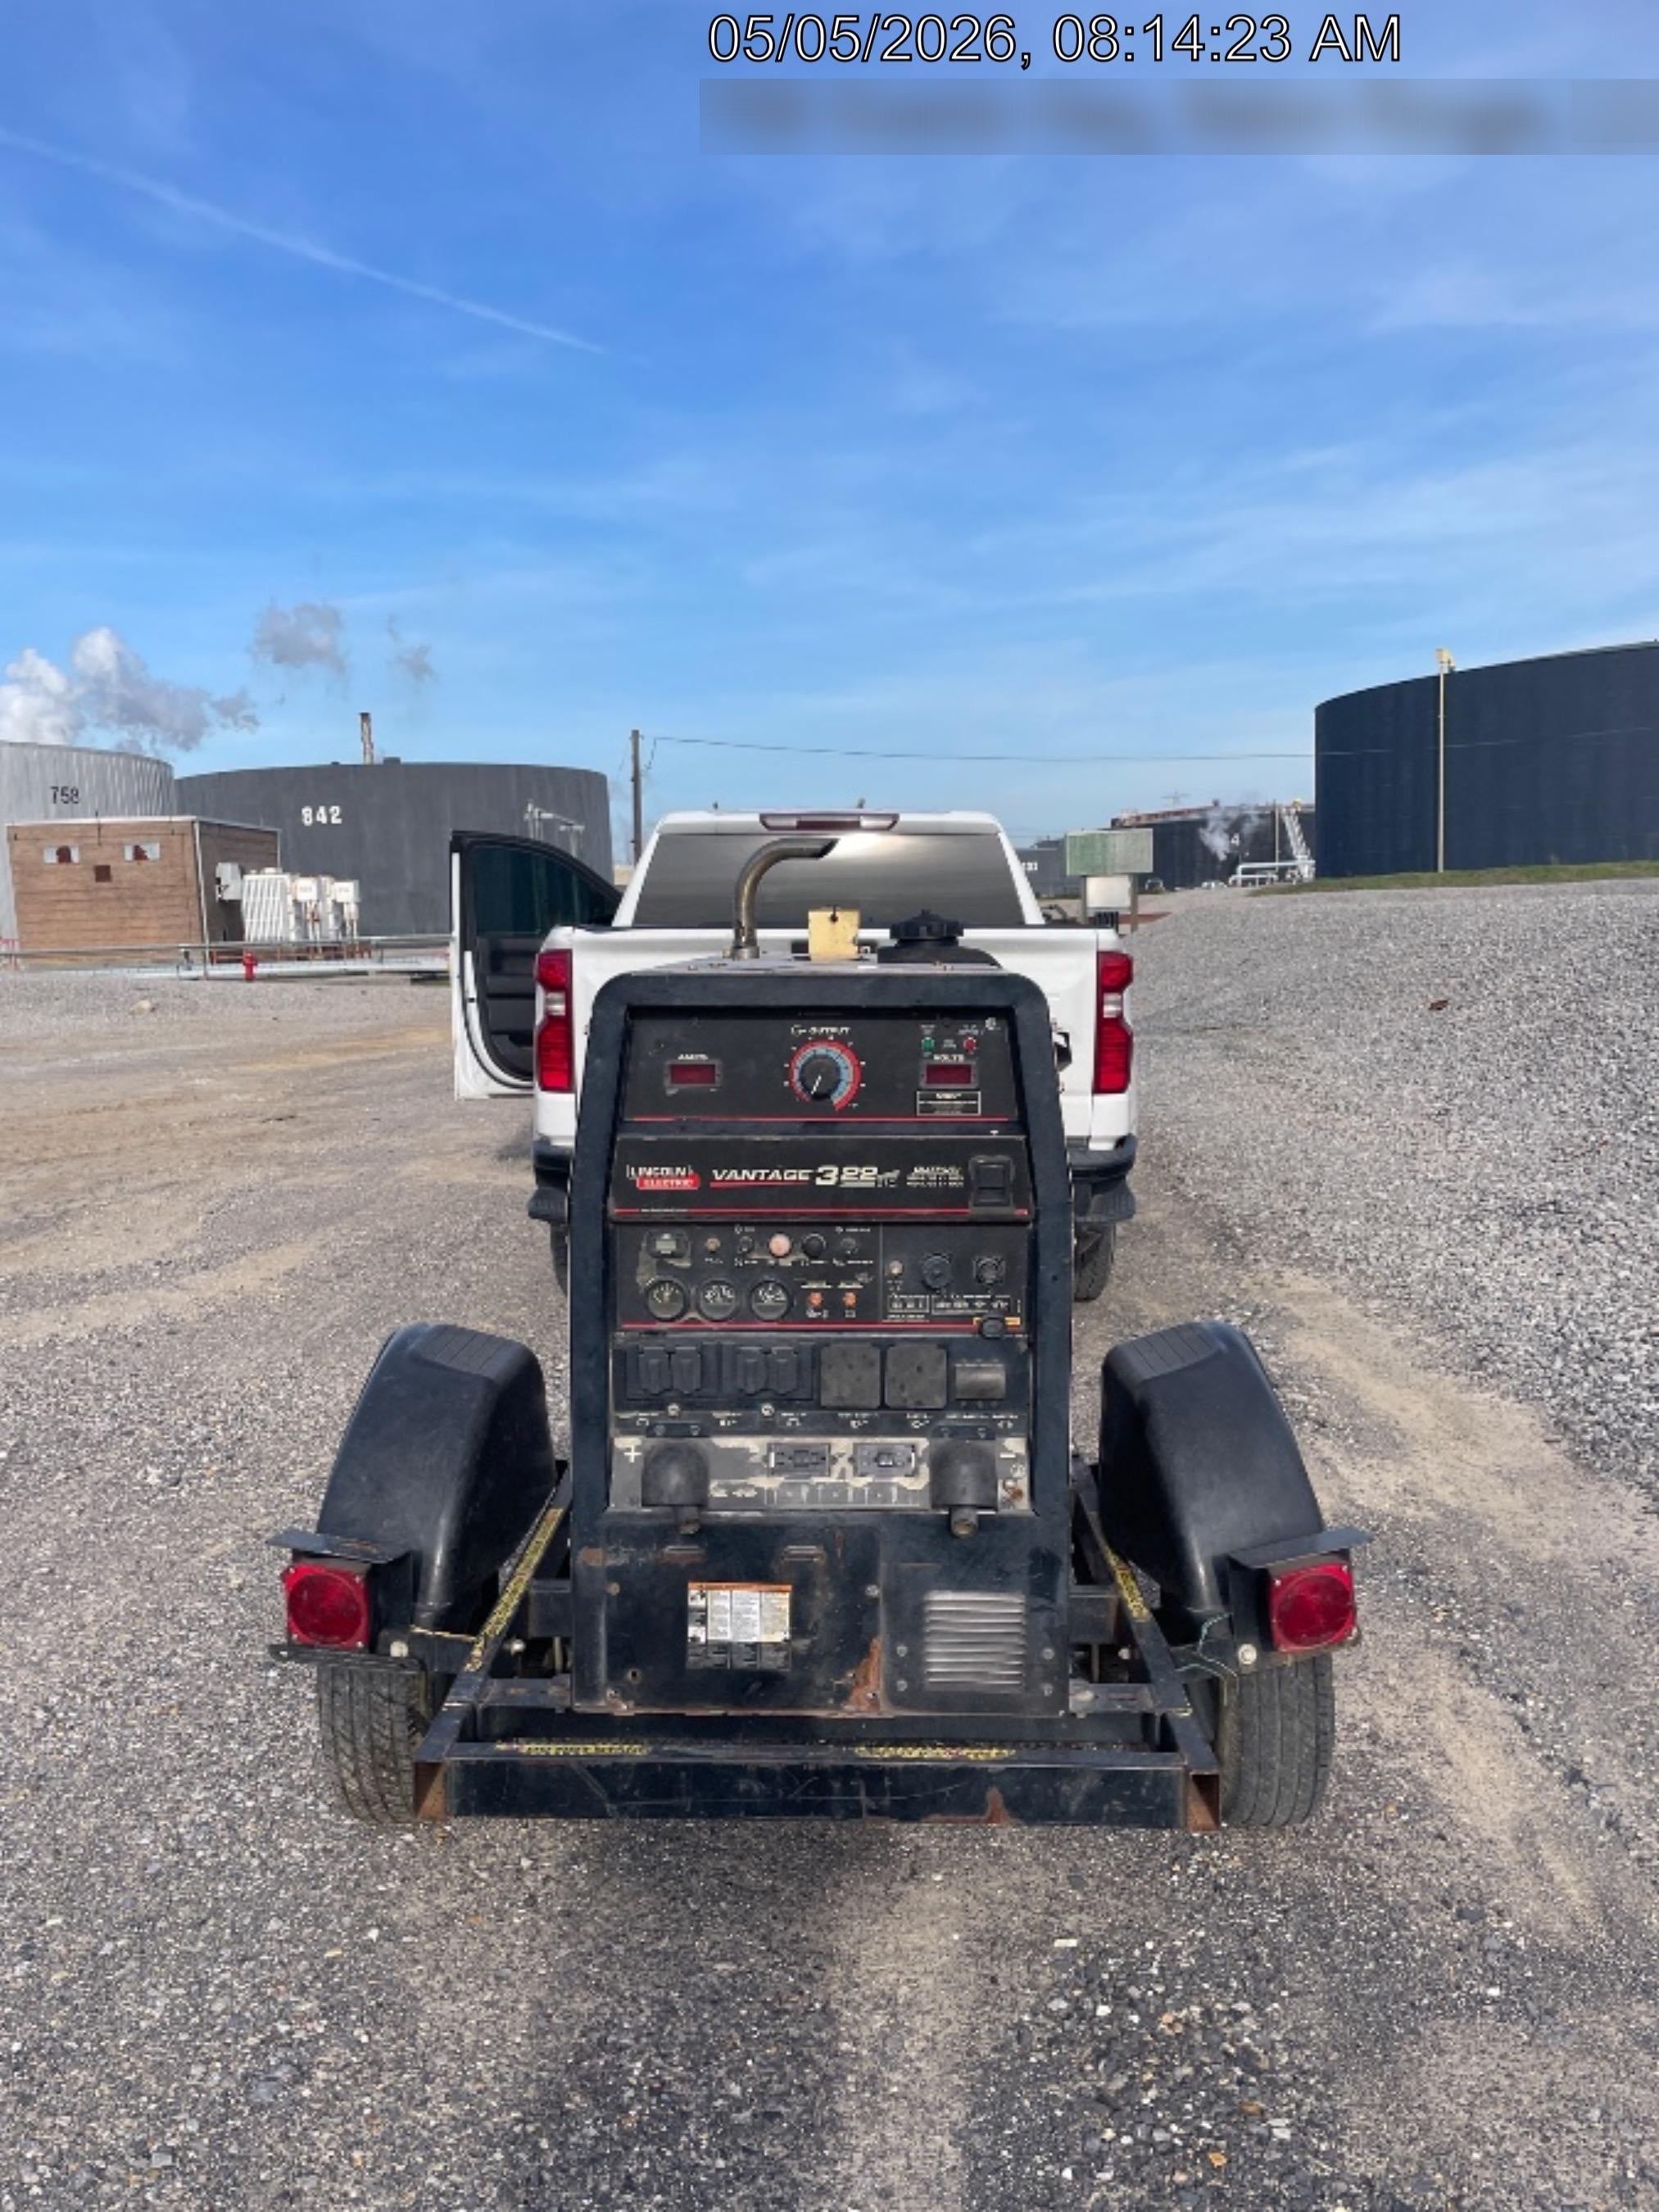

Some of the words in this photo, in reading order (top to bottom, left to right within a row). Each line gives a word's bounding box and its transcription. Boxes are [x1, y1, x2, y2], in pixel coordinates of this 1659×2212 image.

[51, 786, 79, 805] 758
[301, 805, 342, 827] 842
[630, 1166, 687, 1177] LINCOLN
[711, 1169, 814, 1181] VANTAGE
